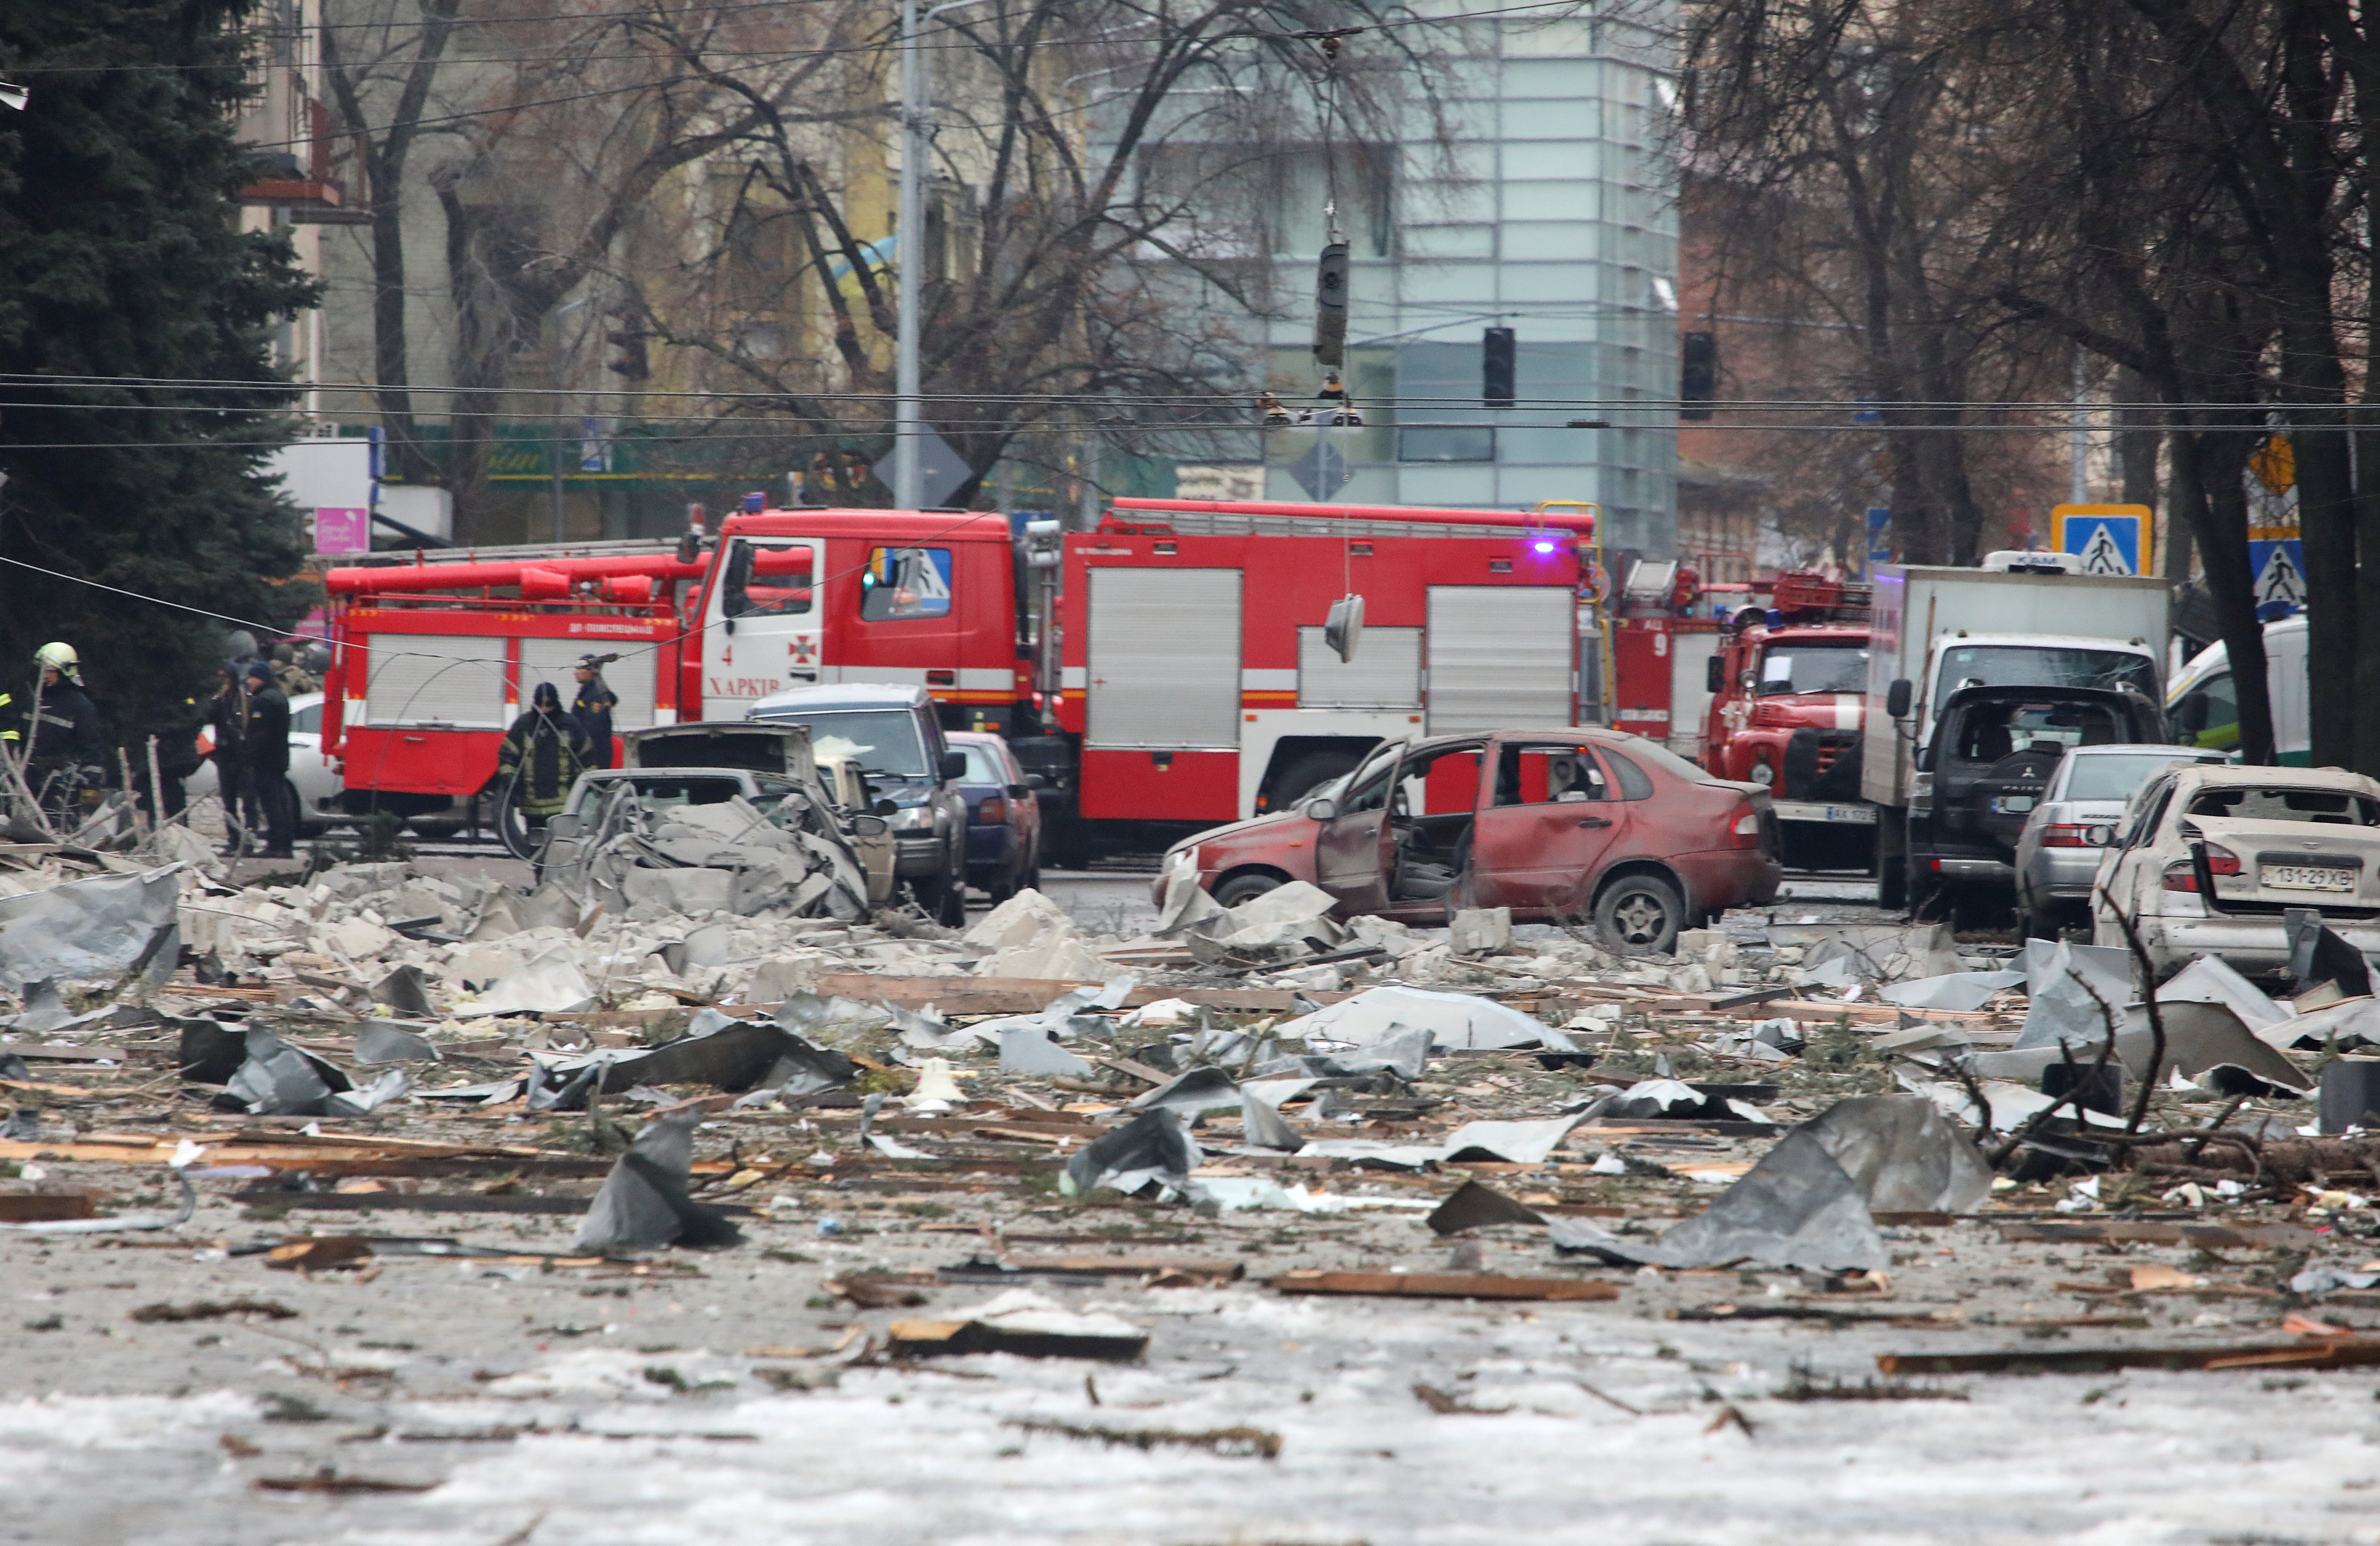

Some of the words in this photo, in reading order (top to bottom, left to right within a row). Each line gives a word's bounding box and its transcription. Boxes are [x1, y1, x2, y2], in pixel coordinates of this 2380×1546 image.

[1655, 633, 1667, 656] 9
[721, 645, 733, 667] 4
[709, 677, 780, 696] ХАРКІВ
[2278, 868, 2325, 885] 131-29
